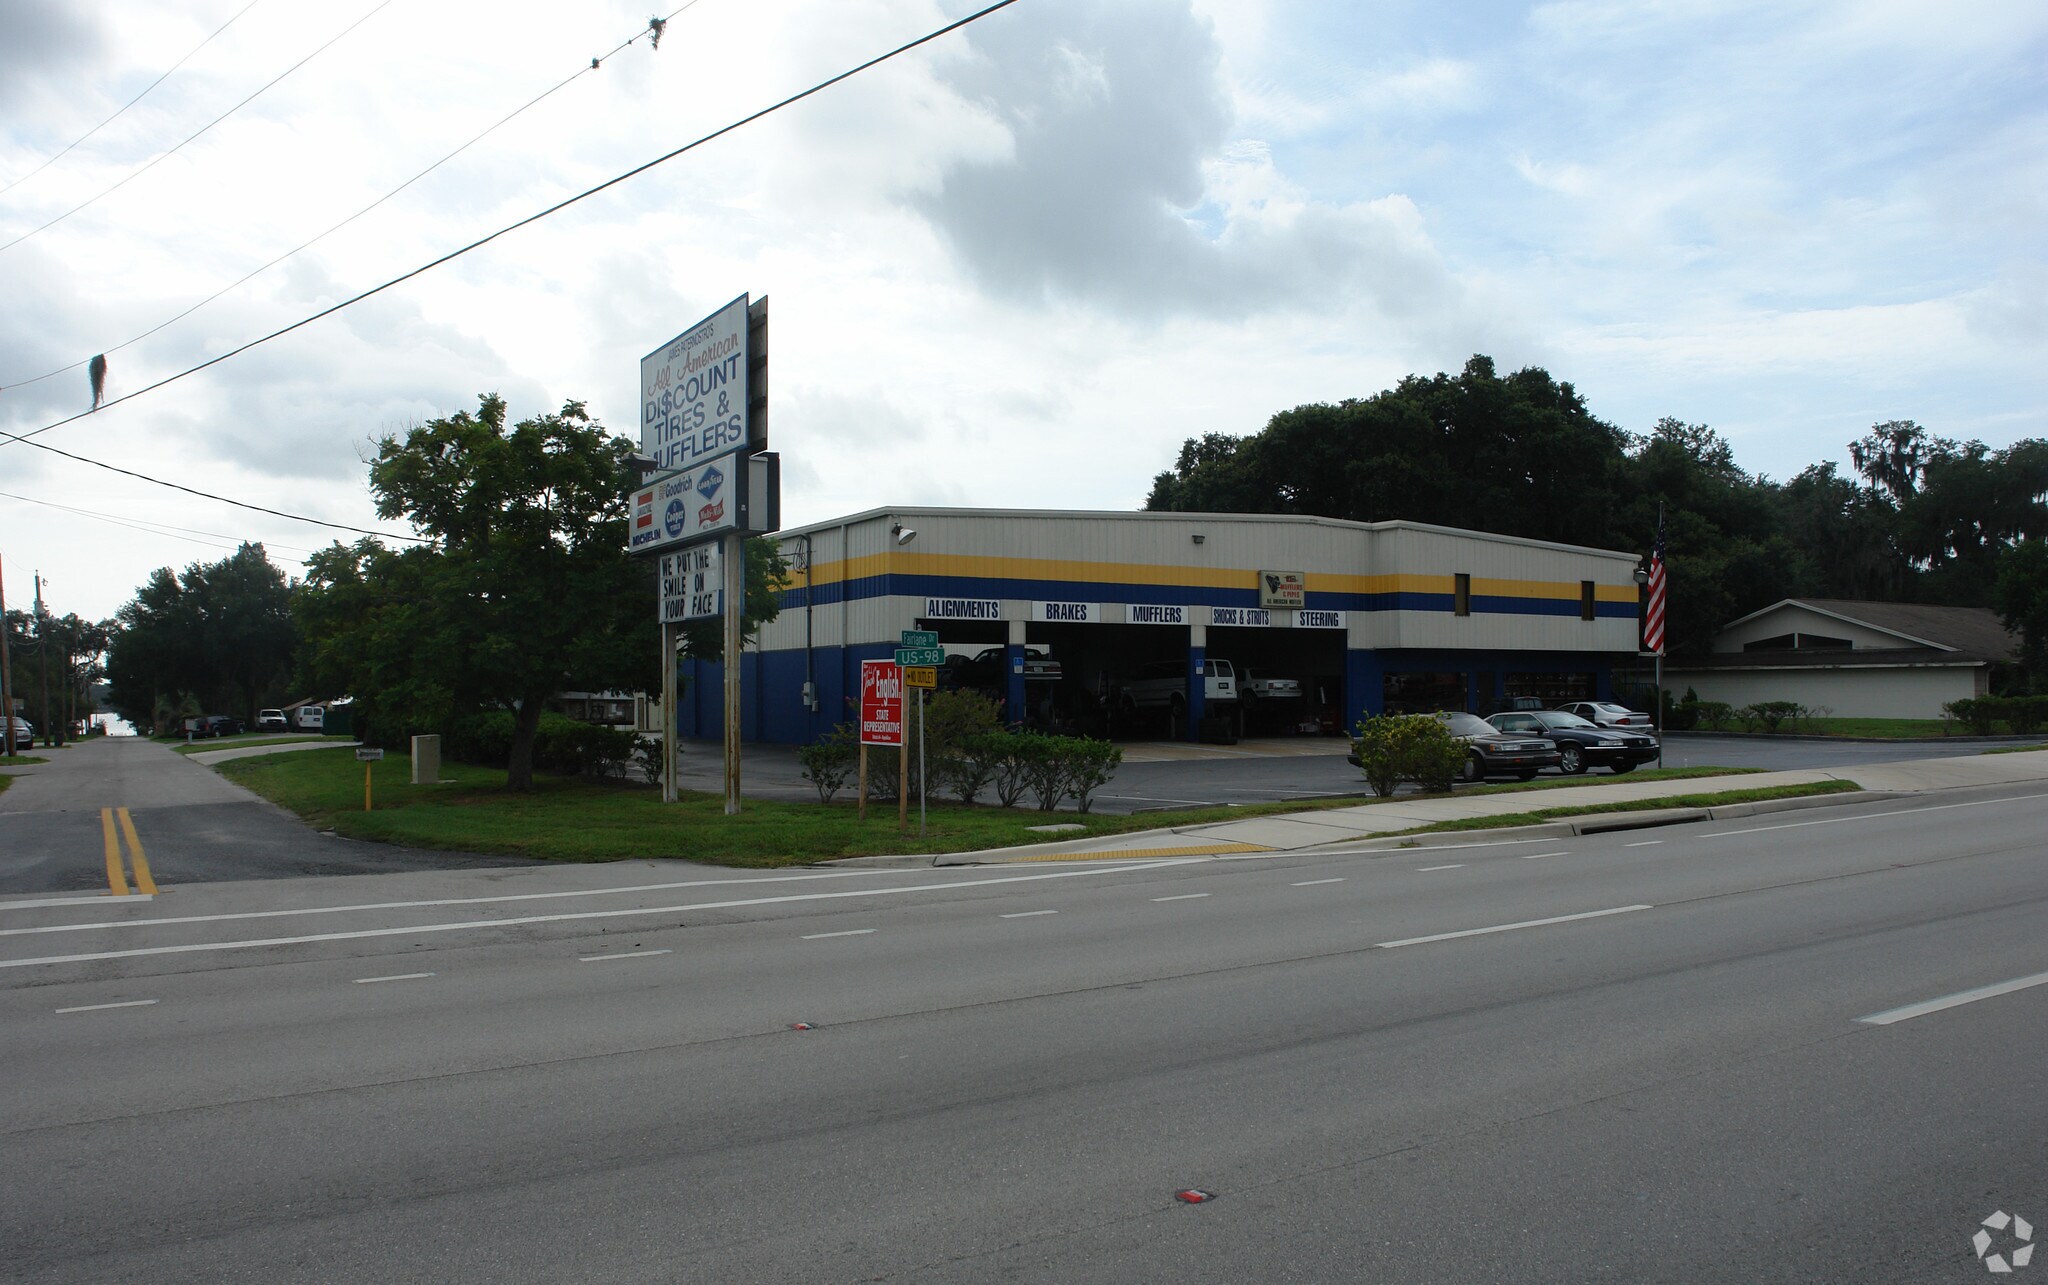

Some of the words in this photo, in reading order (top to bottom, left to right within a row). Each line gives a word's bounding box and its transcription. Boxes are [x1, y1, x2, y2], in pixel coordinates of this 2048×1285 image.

[677, 332, 739, 380] American
[654, 402, 706, 445] TIRES
[716, 390, 730, 418] &
[666, 508, 685, 524] Cooper
[632, 529, 661, 547] MICHELIN
[661, 557, 672, 576] WE
[676, 552, 691, 574] PUT
[694, 548, 709, 570] THE
[663, 576, 686, 597] SMILE
[694, 572, 704, 593] ON
[665, 598, 685, 619] YOUR
[692, 593, 712, 615] FACE
[928, 599, 999, 619] ALIGNMENTS
[1046, 603, 1087, 620] BRAKES
[1132, 606, 1182, 623] MUFFLERS
[1213, 608, 1237, 625] SHOCKS
[1239, 609, 1245, 625] &
[1247, 610, 1270, 626] STRUTS
[1300, 612, 1339, 627] STEERING
[903, 632, 927, 646] Fairlane
[901, 650, 940, 664] US-98
[917, 671, 934, 684] OUTLET
[876, 668, 899, 707] English
[876, 709, 889, 720] STATE
[863, 721, 900, 734] REPRESENTATIVE
